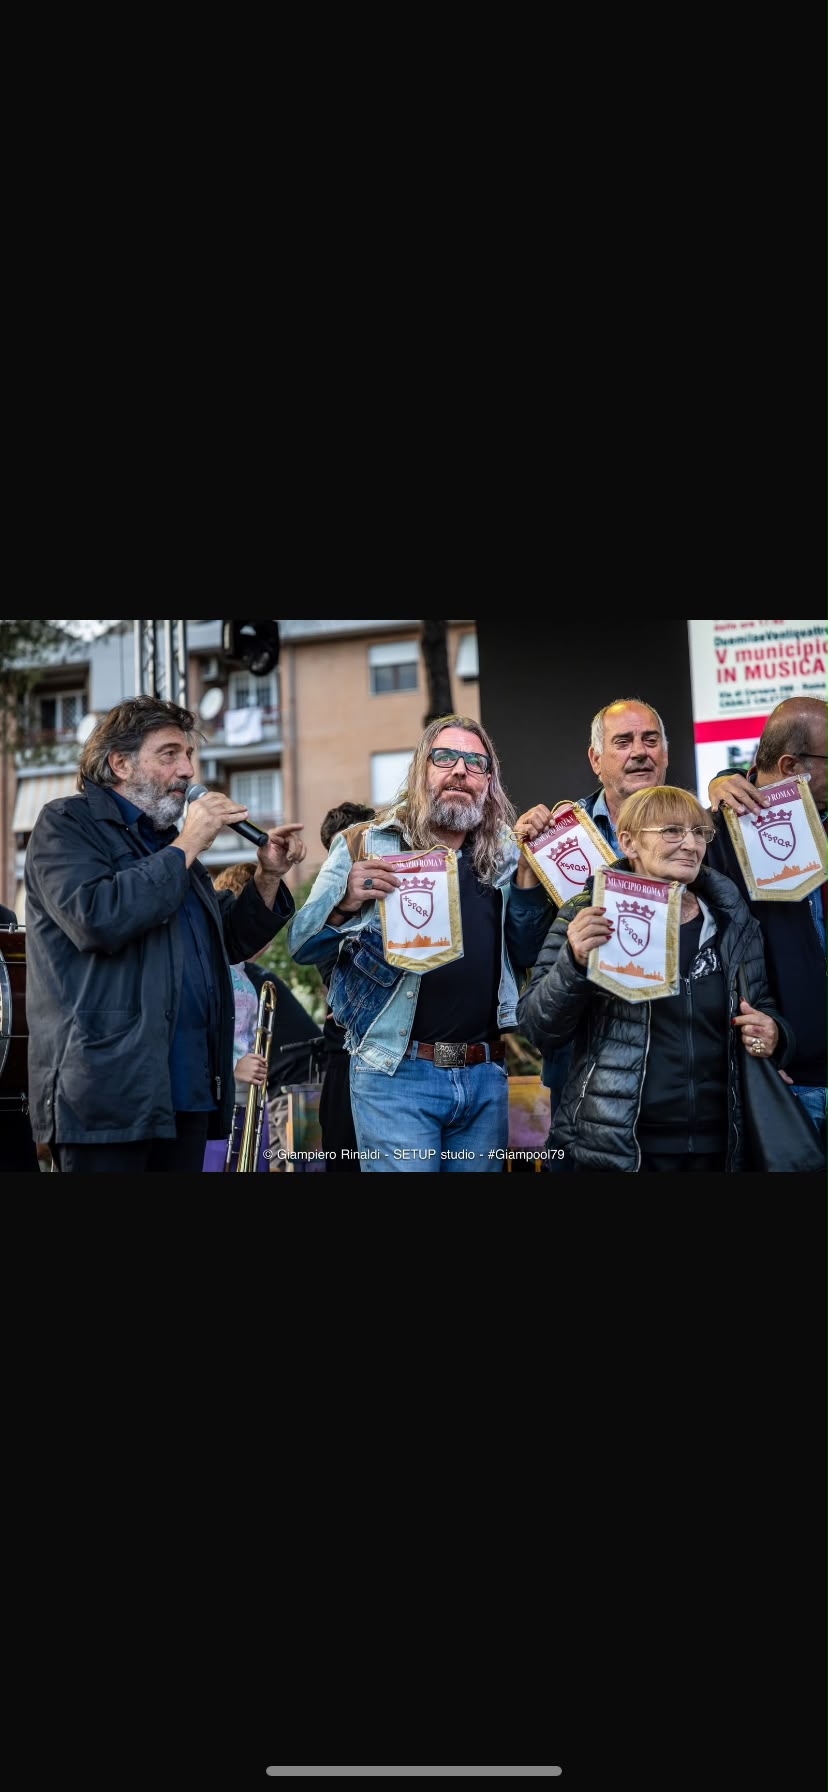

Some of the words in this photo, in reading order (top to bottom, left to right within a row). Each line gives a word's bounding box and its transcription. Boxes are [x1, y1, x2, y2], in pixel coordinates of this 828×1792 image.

[716, 648, 728, 665] V
[717, 666, 737, 684] IN
[744, 657, 826, 681] MUSICA
[770, 790, 792, 802] ROMA
[419, 858, 437, 868] ROMA
[607, 877, 641, 892] MUNICIPIO
[642, 884, 661, 897] ROMA
